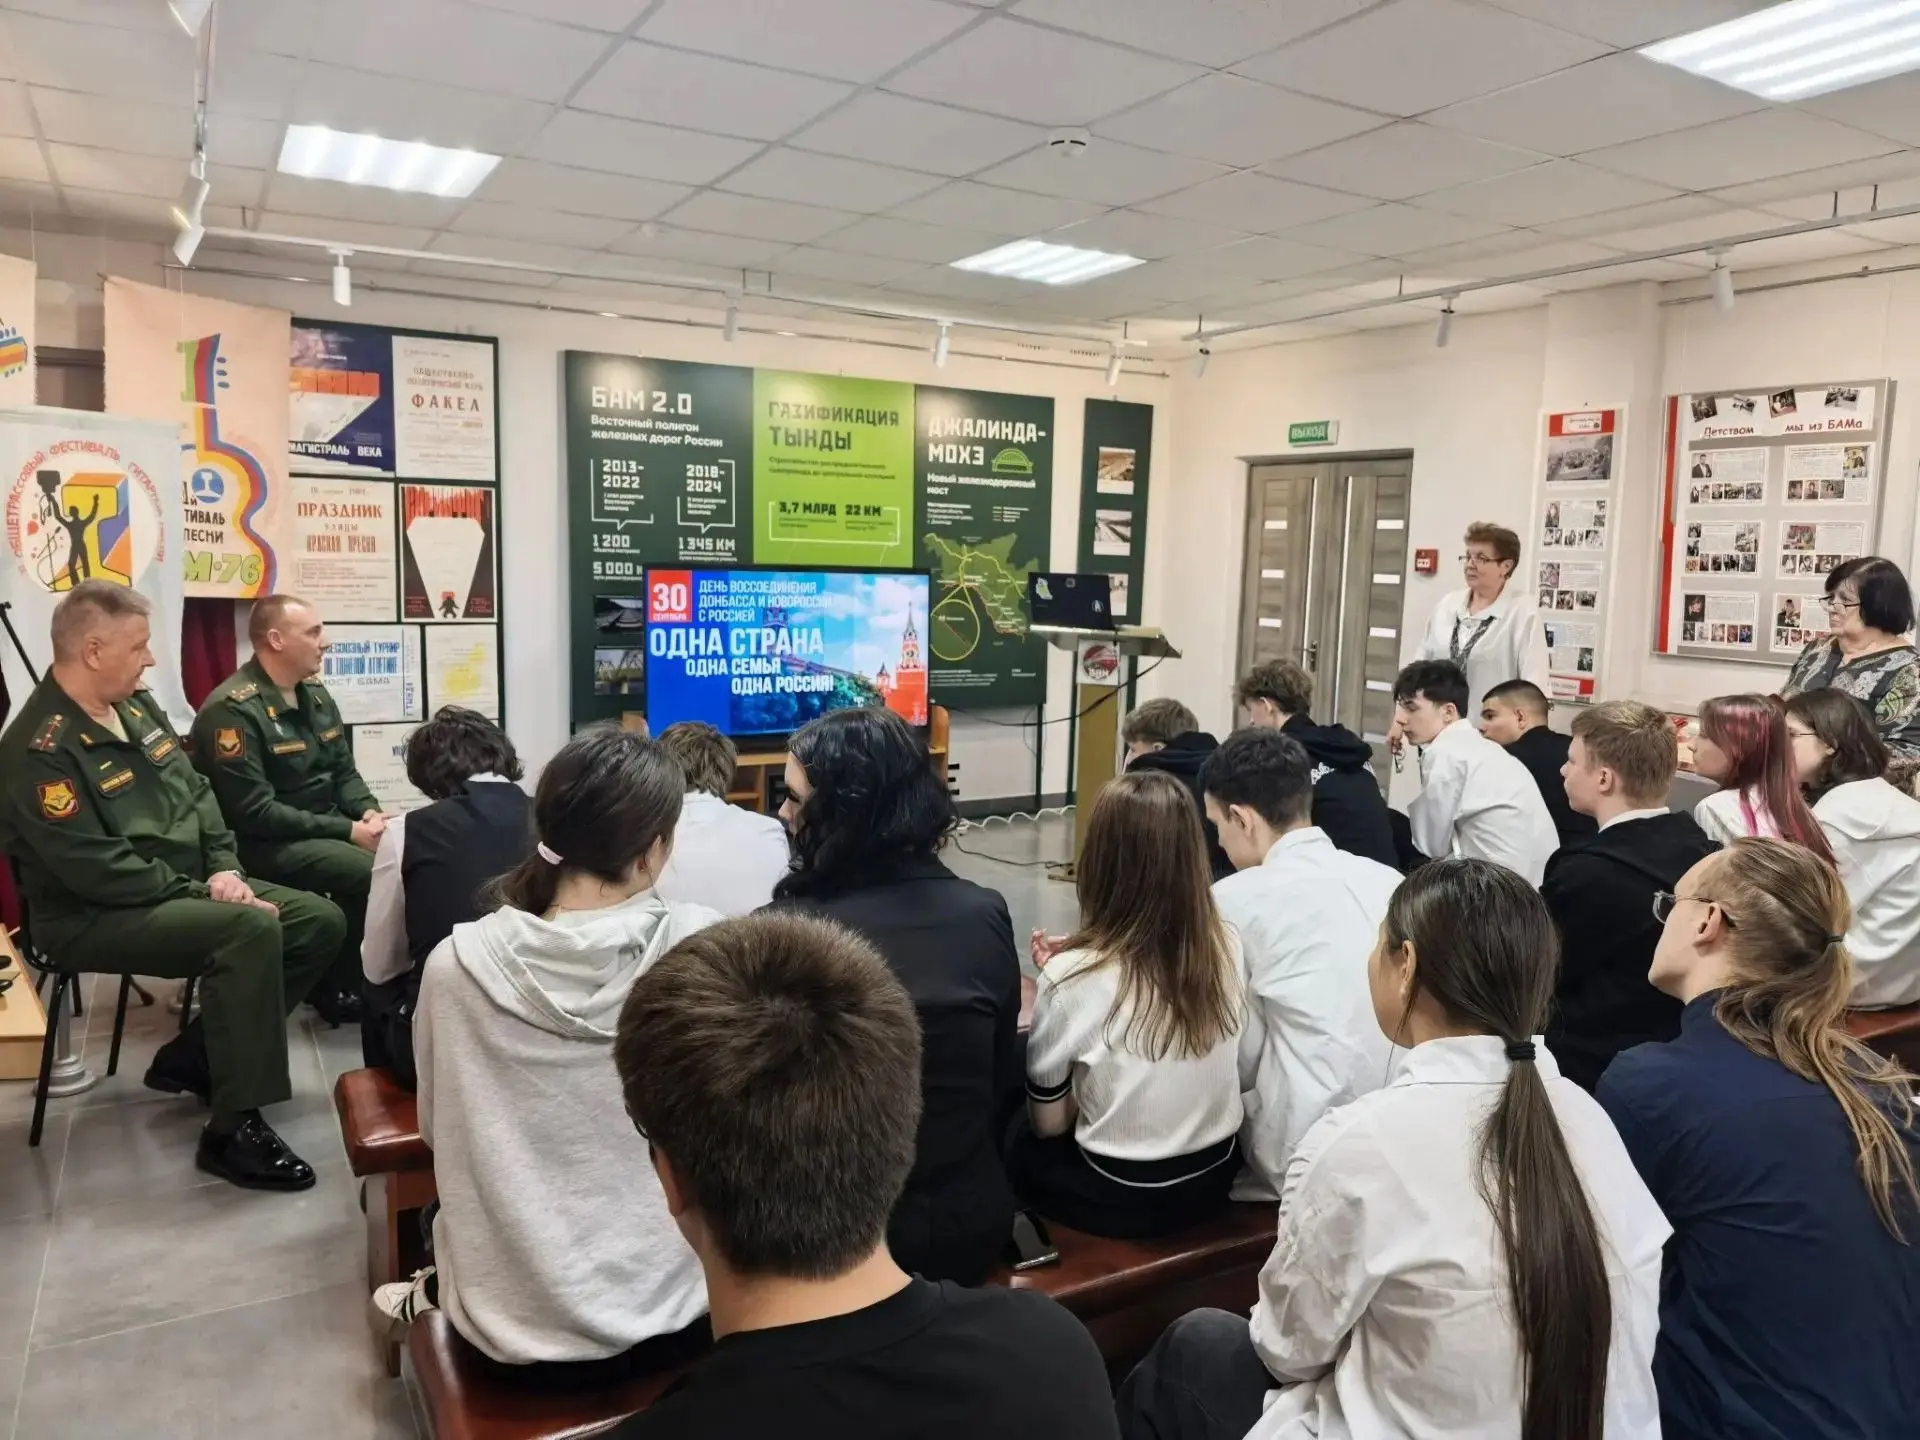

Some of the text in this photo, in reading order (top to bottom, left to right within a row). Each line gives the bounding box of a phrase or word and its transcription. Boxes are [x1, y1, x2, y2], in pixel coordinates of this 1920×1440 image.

[411, 393, 480, 412] ФАКЕЛ
[592, 386, 692, 415] БАМ 2.0
[768, 401, 899, 427] ГАЗИФИКАЦИЯ
[591, 414, 699, 433] Восточный полигон
[1785, 423, 1804, 432] мы
[1808, 422, 1823, 432] из
[1827, 419, 1863, 430] БАМа
[591, 430, 723, 448] железных дорог России
[769, 425, 852, 452] ТЫНДЫ
[1292, 425, 1325, 439] ВЫХОД
[49, 440, 121, 462] ФЕСТИВАЛЬ
[357, 447, 382, 458] ВЕКА
[928, 443, 984, 466] МОХЭ
[602, 459, 644, 473] 2013-
[602, 474, 640, 488] 2022
[686, 479, 722, 493] 2024
[184, 509, 225, 525] ТИВАЛЬ
[297, 502, 383, 518] ПРАЗДНИК
[803, 503, 837, 516] МЛРД
[845, 504, 881, 517] 22 КМ
[716, 538, 735, 551] КМ
[698, 580, 817, 594] ДЕНЬ ВОССОЕДИНЕНИЯ
[653, 583, 687, 612] 30
[698, 594, 756, 608] ДОНБАССА
[758, 595, 766, 608] И
[699, 607, 755, 622] С РОССИЕЙ
[650, 627, 824, 659] ОДНА СТРАНА
[685, 657, 781, 678] ОДНА СЕМЬЯ
[732, 675, 834, 696] ОДНА РОССИЯ!
